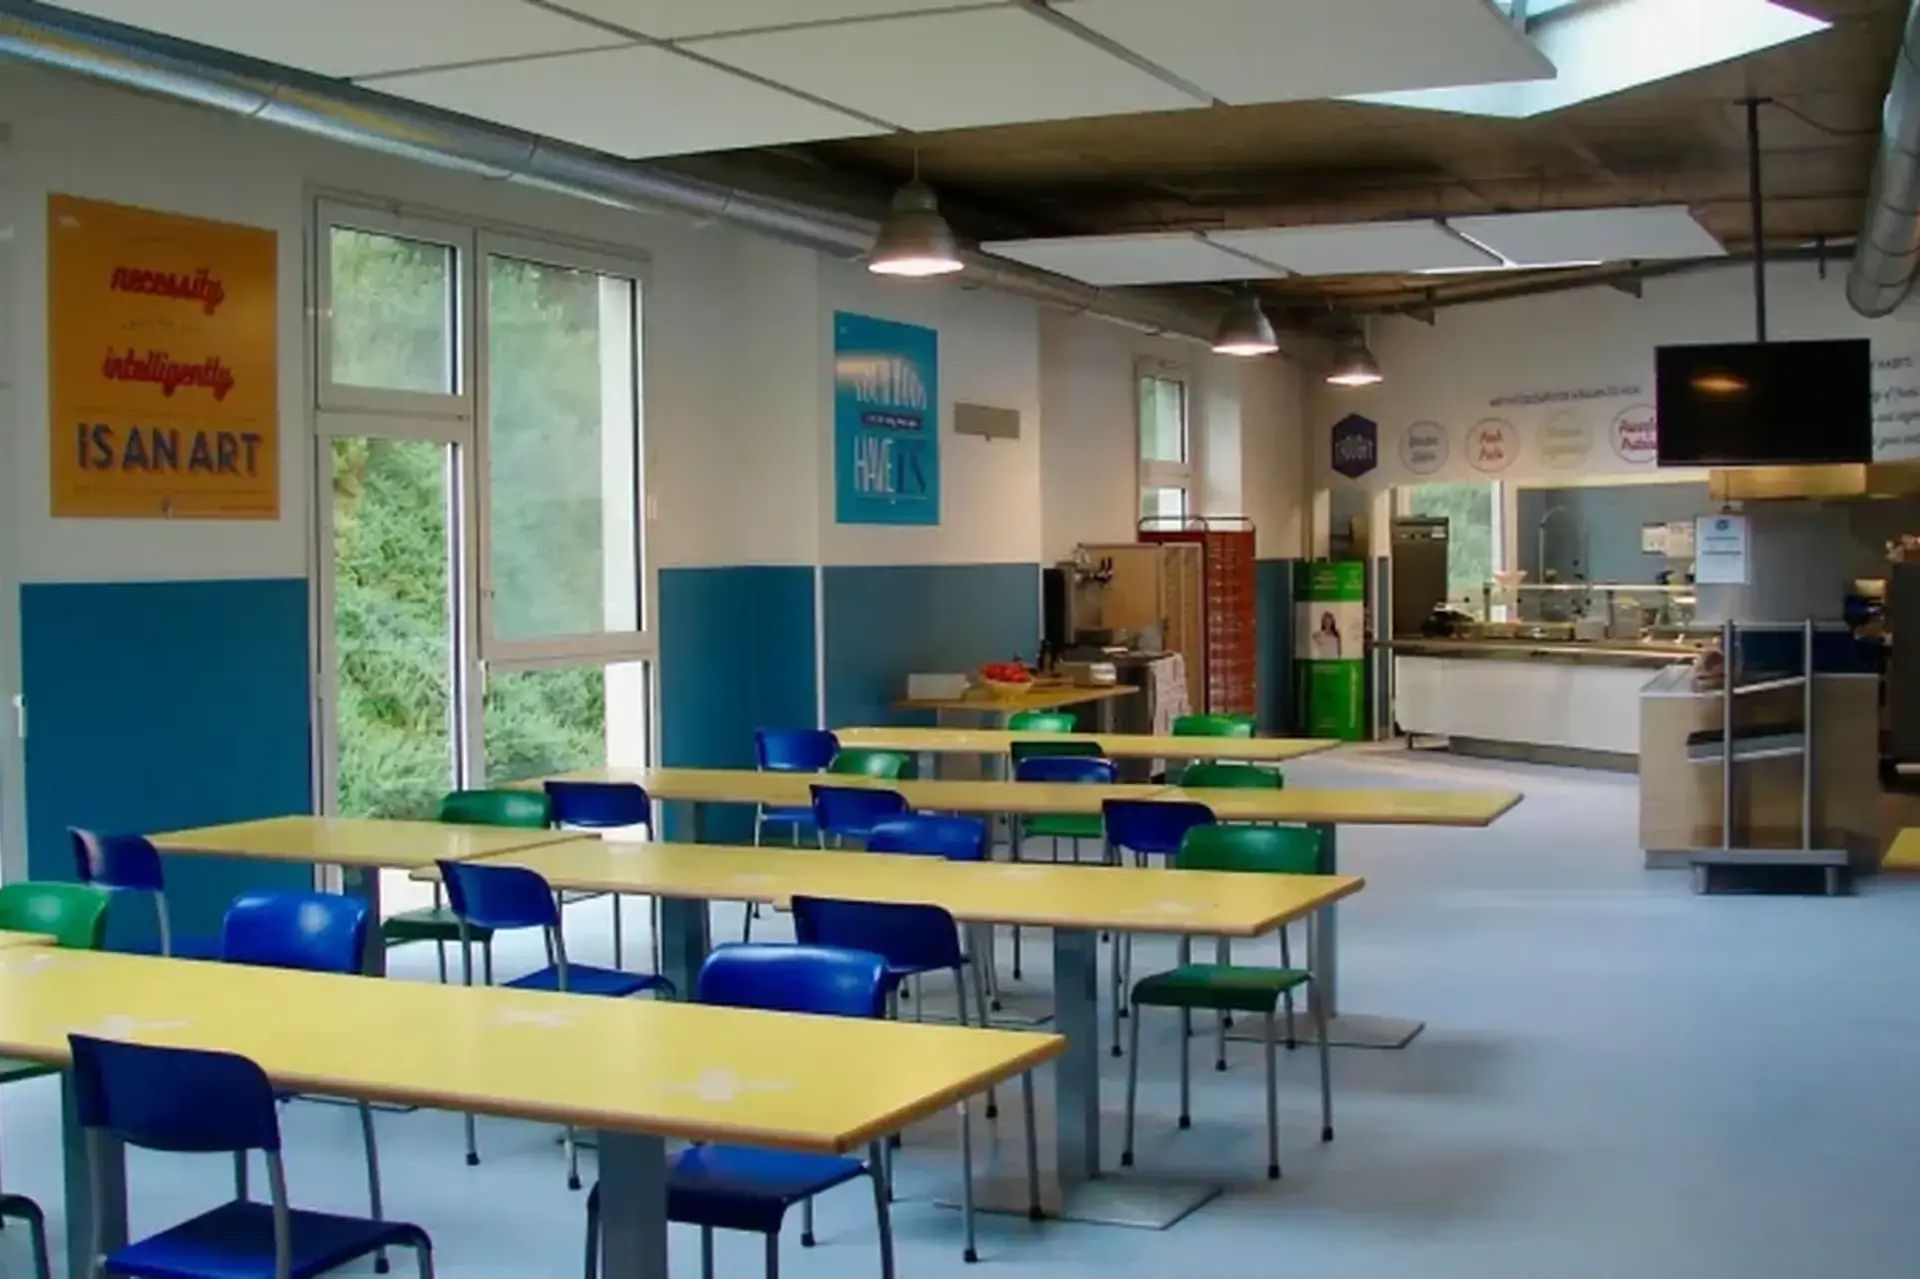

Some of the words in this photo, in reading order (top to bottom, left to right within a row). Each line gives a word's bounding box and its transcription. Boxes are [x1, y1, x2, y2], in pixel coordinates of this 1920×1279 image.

[110, 265, 226, 315] necessity
[103, 346, 235, 402] intelligently
[76, 422, 114, 470] IS
[121, 424, 180, 472] AN
[188, 430, 264, 477] ART
